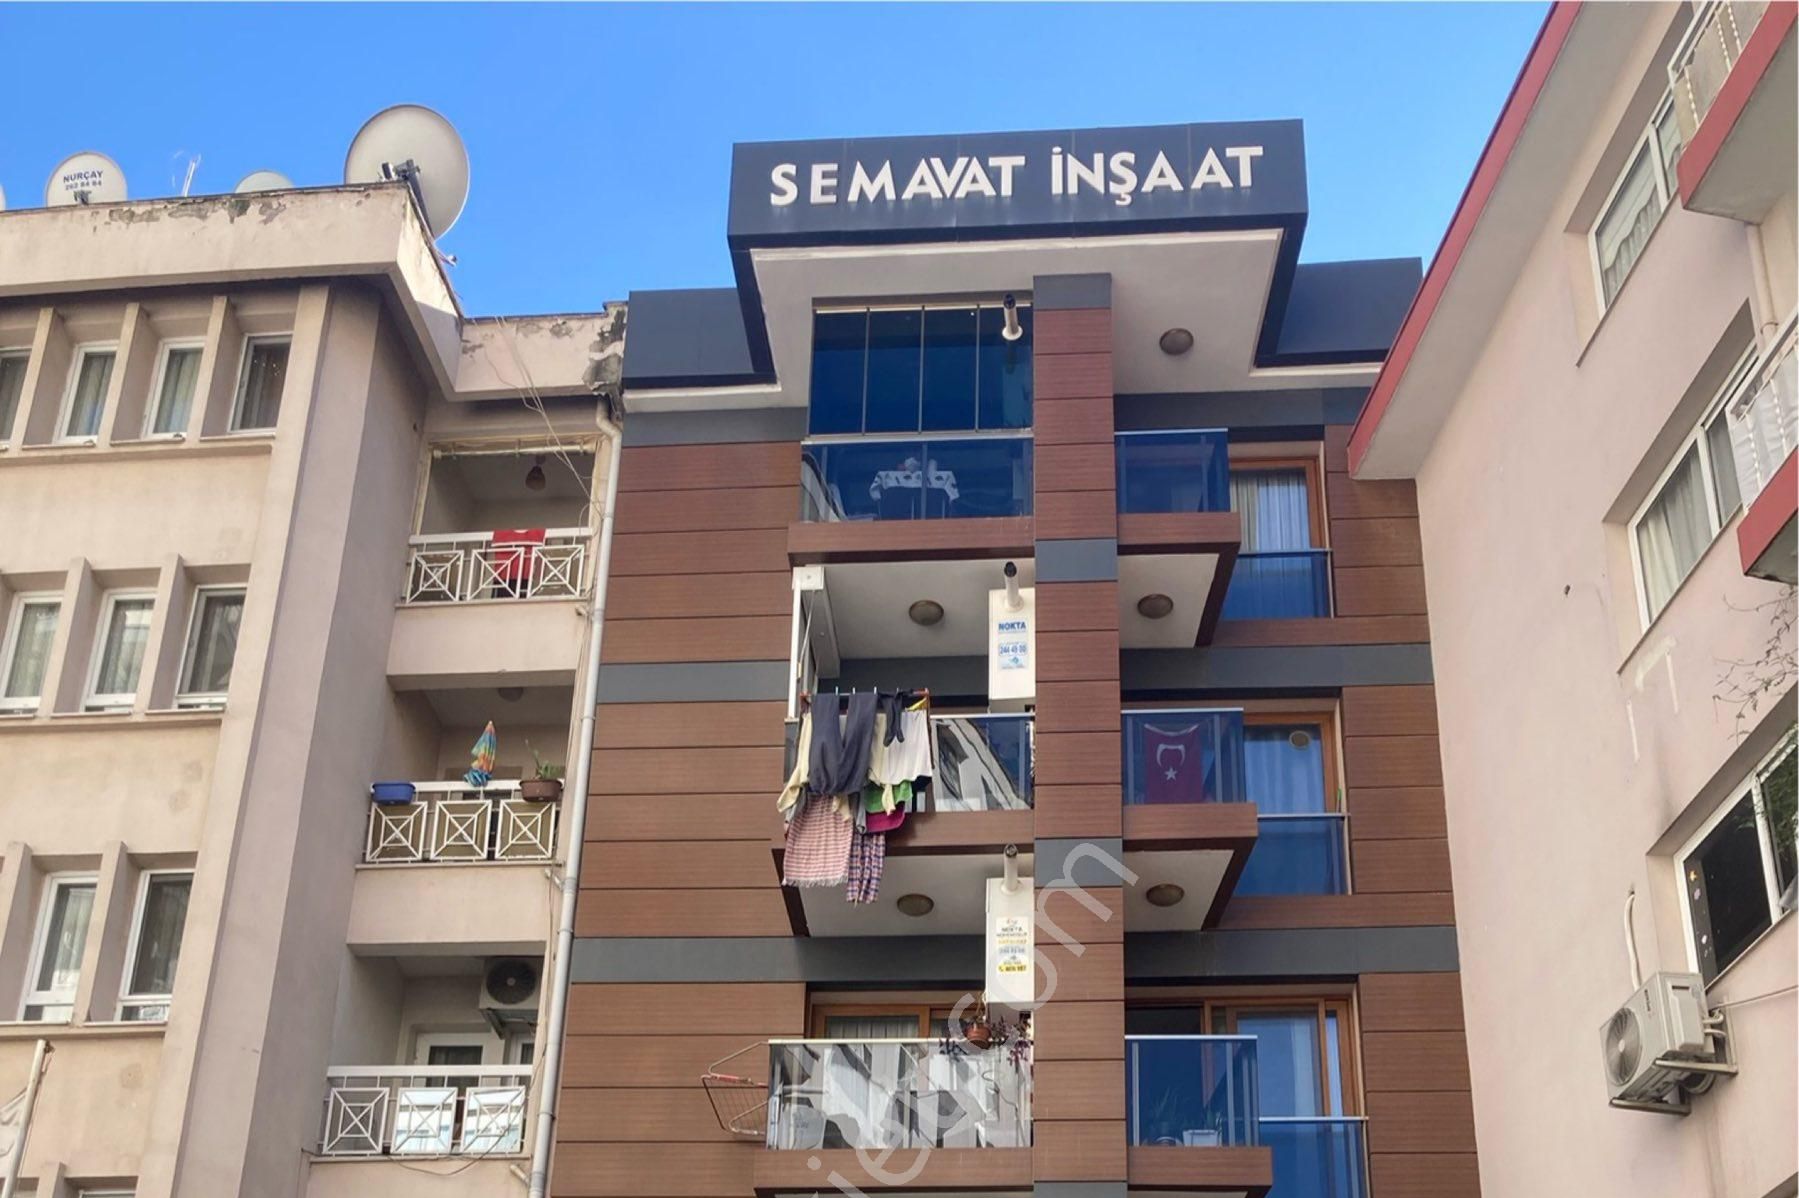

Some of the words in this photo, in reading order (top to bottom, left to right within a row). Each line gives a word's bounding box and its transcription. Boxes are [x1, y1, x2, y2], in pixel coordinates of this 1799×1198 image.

[63, 170, 103, 183] NURÇAY
[770, 155, 1026, 206] SEMAVAT
[1051, 146, 1264, 206] İNŞAAT
[999, 622, 1026, 631] NOKTA
